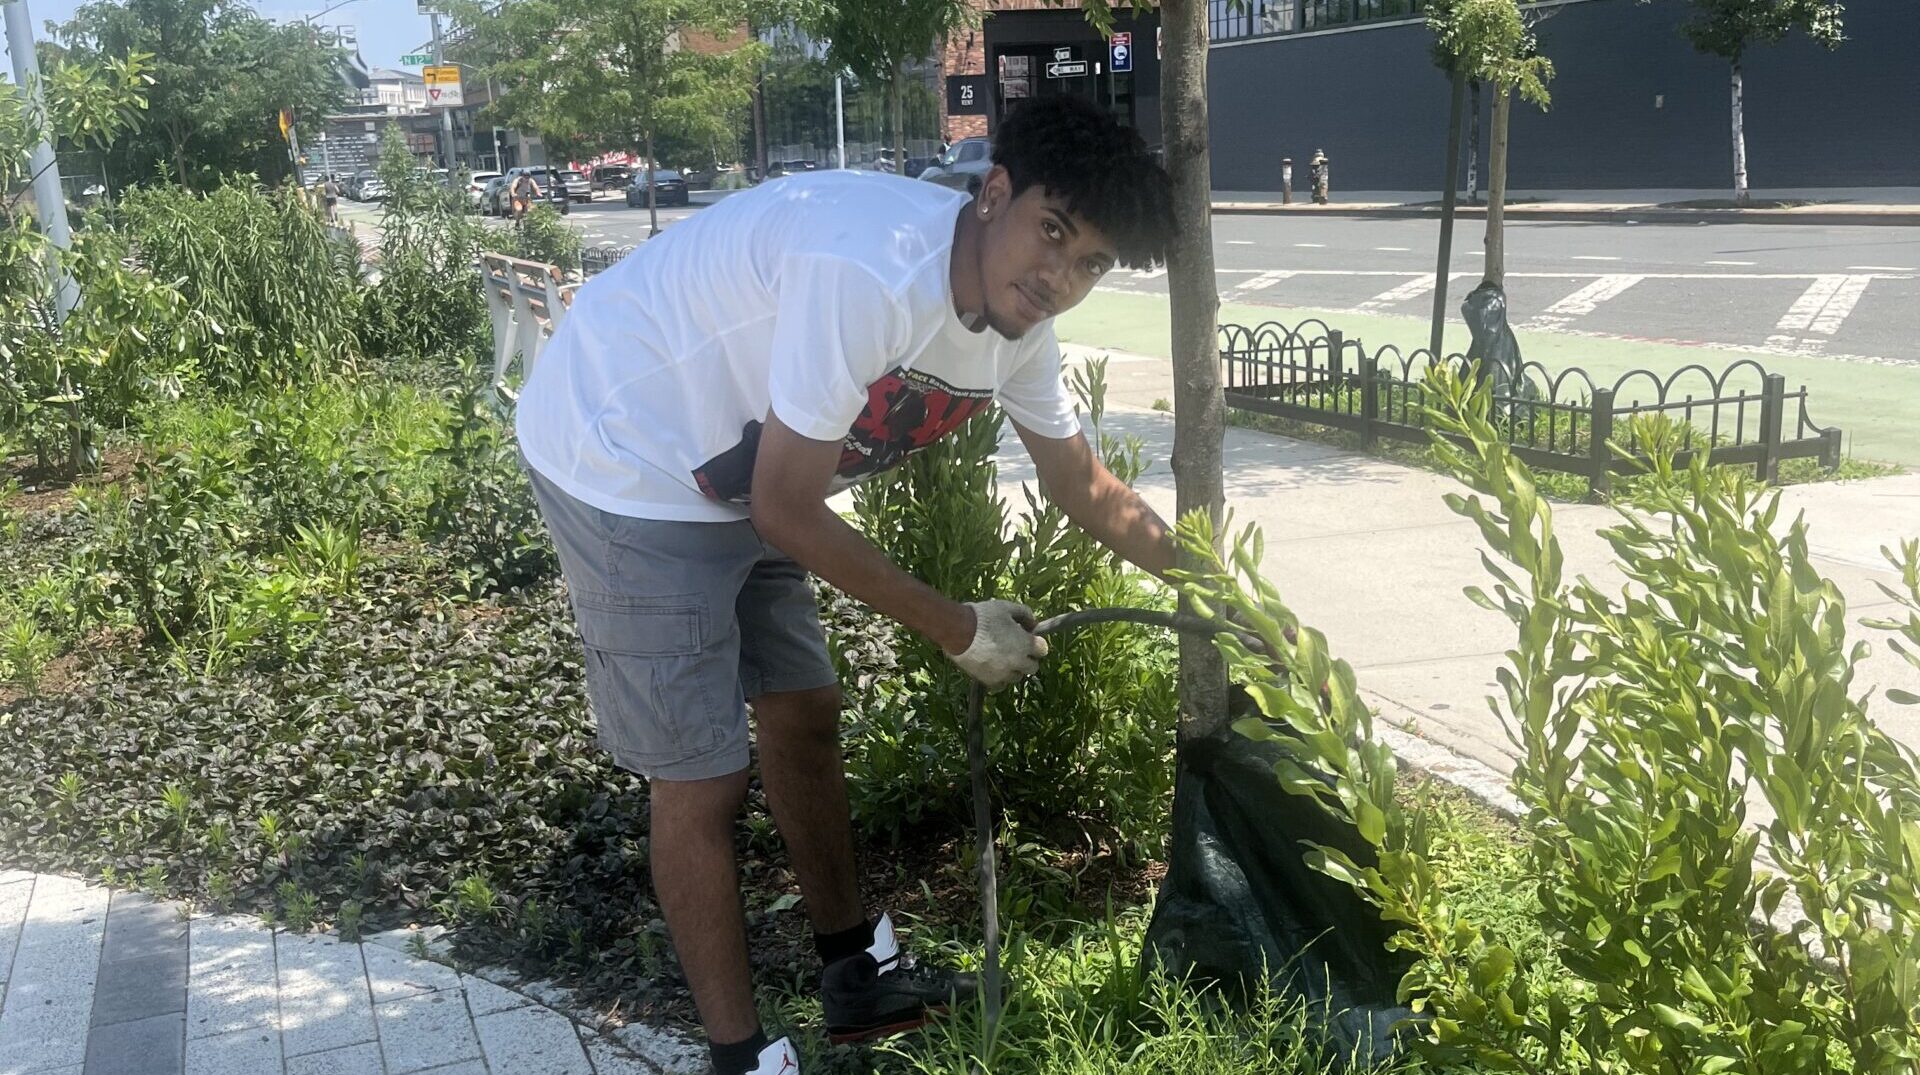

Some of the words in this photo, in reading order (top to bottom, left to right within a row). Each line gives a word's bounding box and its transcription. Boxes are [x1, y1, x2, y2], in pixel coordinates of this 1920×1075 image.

[403, 56, 411, 65] N
[415, 55, 425, 64] 12
[961, 85, 973, 99] 25
